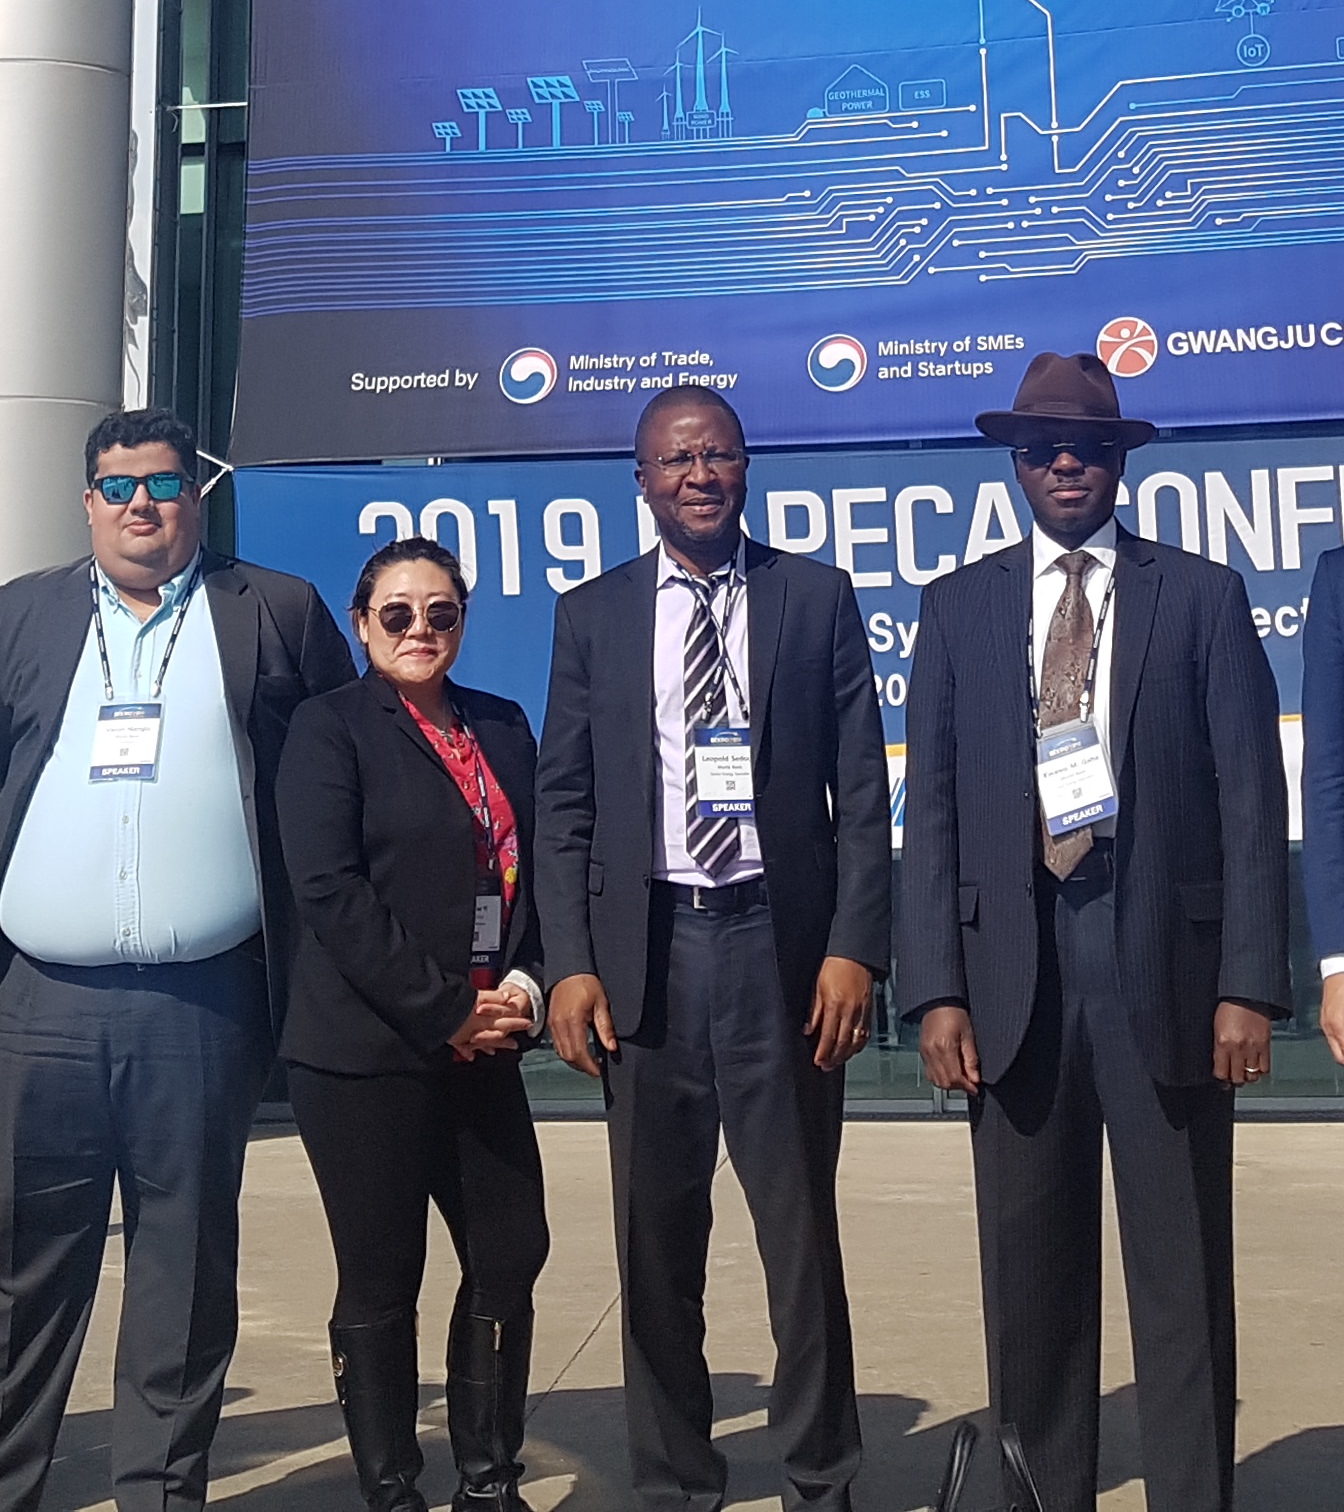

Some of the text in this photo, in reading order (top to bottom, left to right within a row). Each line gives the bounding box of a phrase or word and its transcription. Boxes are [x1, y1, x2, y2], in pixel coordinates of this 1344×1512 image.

[1243, 44, 1265, 57] IoT
[828, 87, 885, 100] GEOTHERMAL
[914, 90, 931, 99] ESS
[842, 100, 873, 111] POWER
[878, 334, 1025, 358] Ministry of SMEs
[1166, 324, 1316, 356] GWANGJU
[569, 349, 714, 372] Ministry of Trade,
[878, 359, 994, 379] and Startups
[351, 368, 479, 393] Supported by
[568, 372, 738, 393] Industry and Energy
[636, 482, 1022, 588] PECA
[101, 767, 141, 776] SPEAKER
[711, 802, 752, 812] SPEAKER
[1061, 804, 1104, 826] SPEAKER
